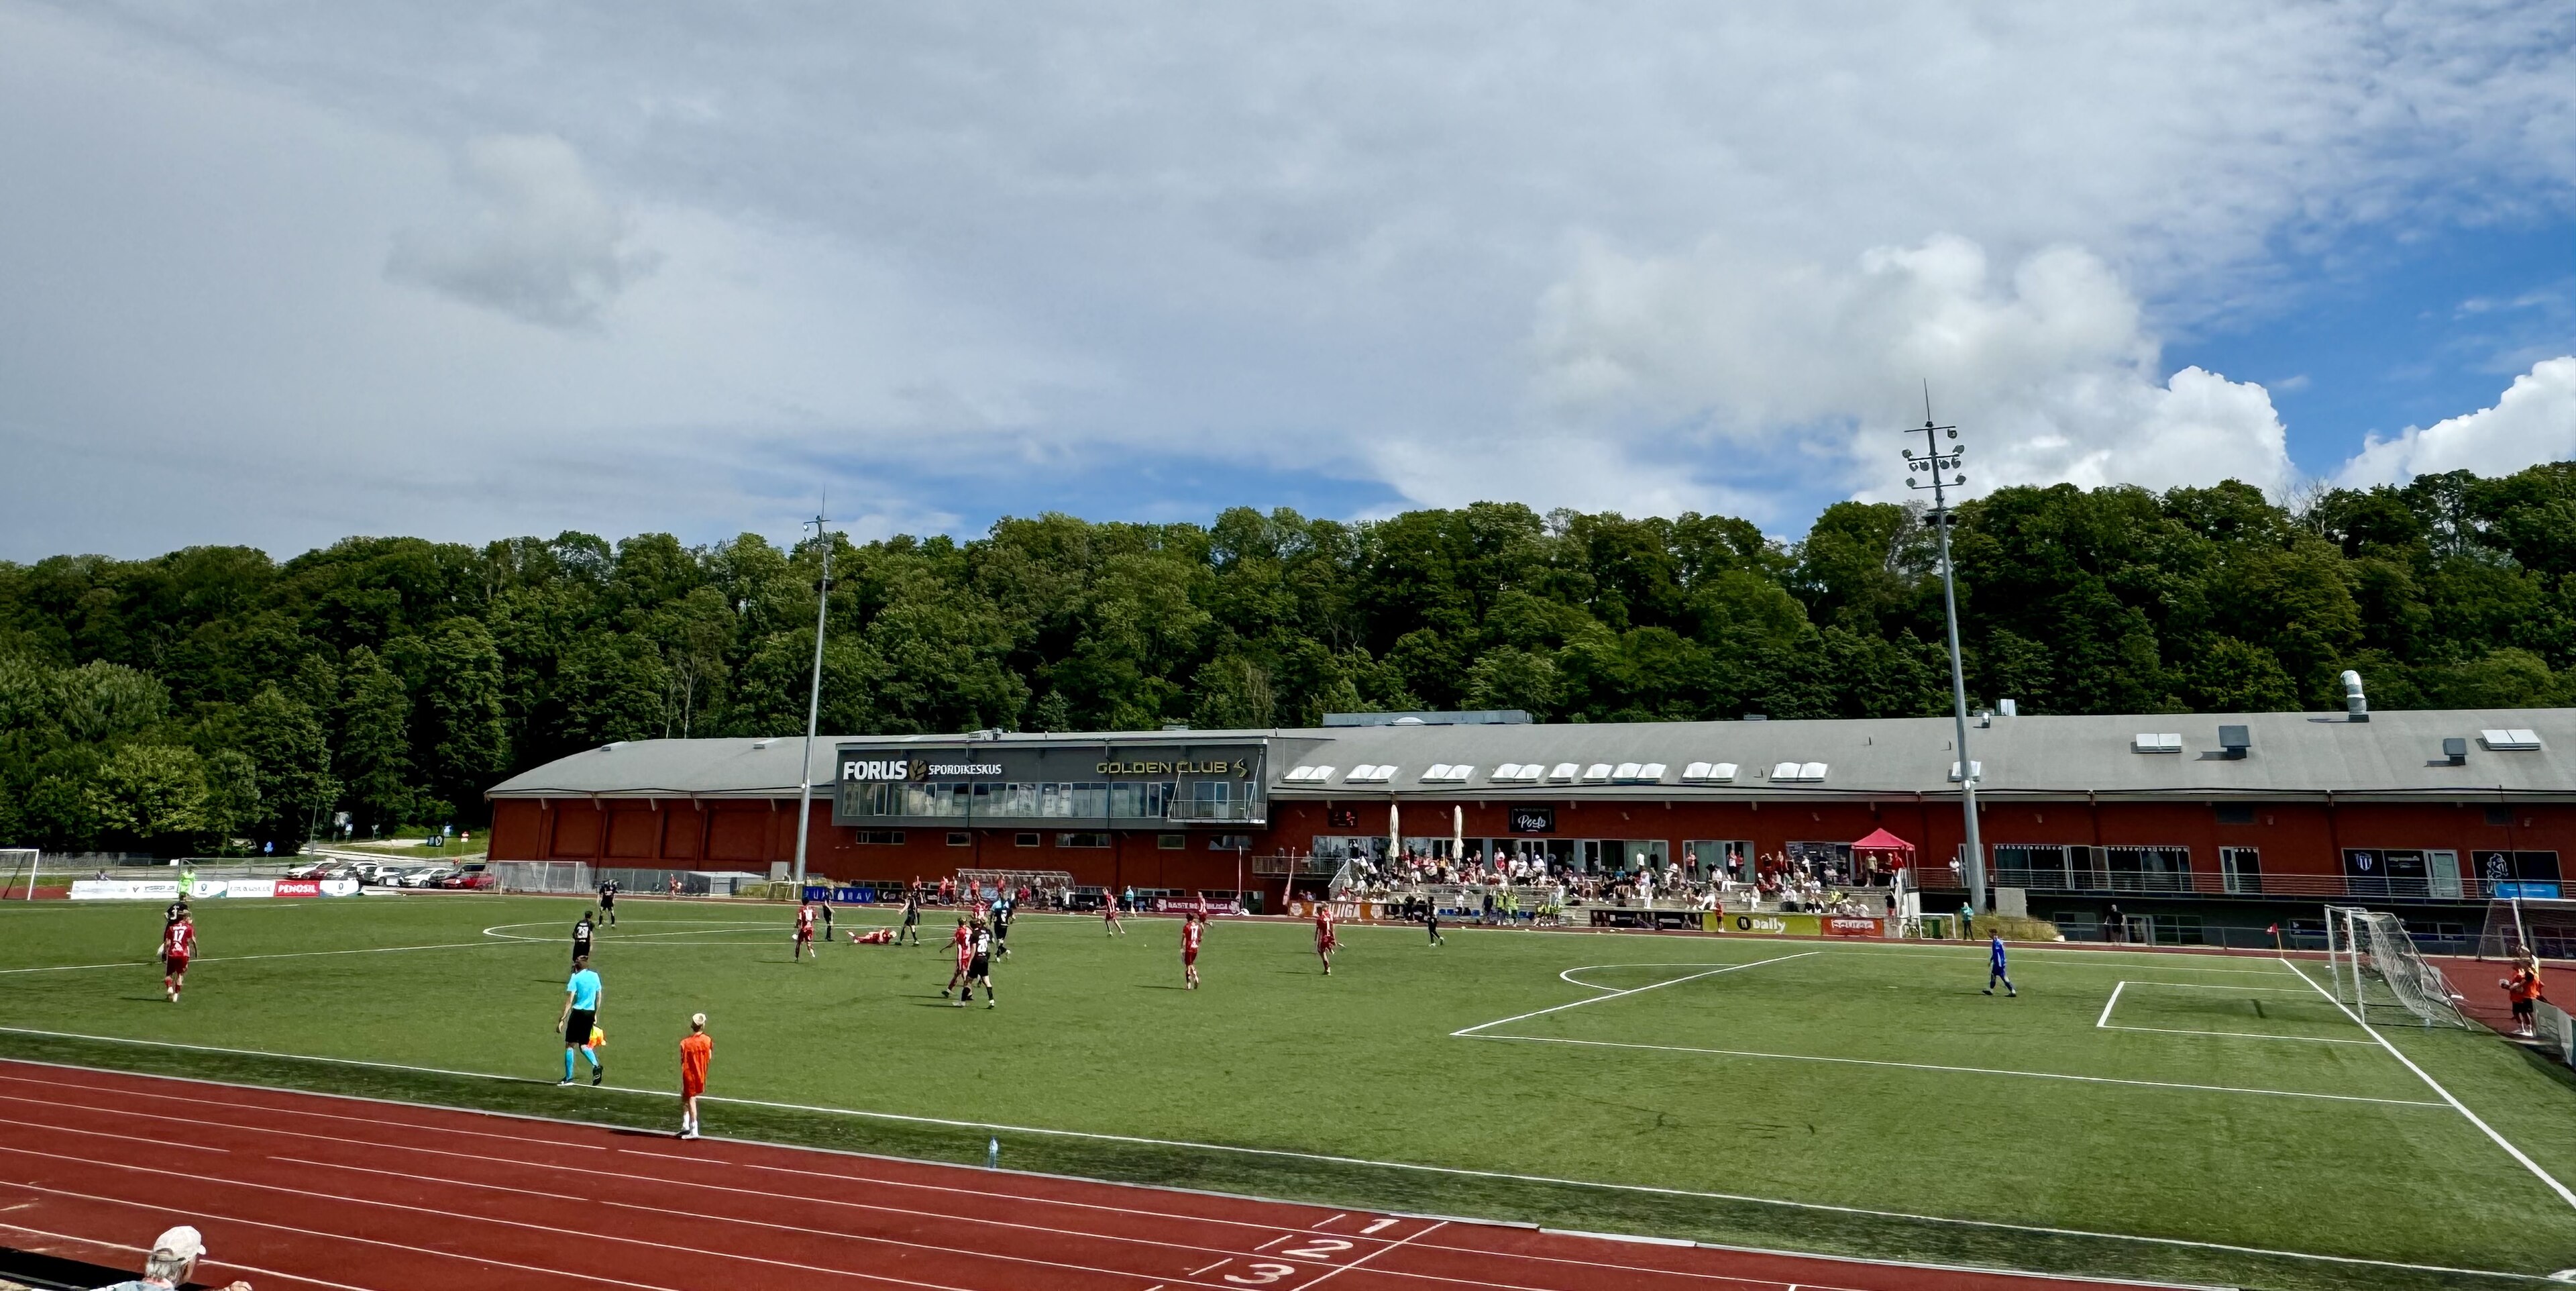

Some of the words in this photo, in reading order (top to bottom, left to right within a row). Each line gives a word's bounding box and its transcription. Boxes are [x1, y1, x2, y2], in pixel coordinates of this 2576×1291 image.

[843, 760, 908, 780] FORUS
[928, 764, 1002, 776] SPORDIKESKUS
[1096, 762, 1172, 774] GOLDEN
[1177, 761, 1228, 774] CLUB
[1752, 917, 1786, 934] Daily
[1359, 1218, 1400, 1234] 1
[1281, 1239, 1354, 1259] 2
[1224, 1263, 1295, 1284] 3
